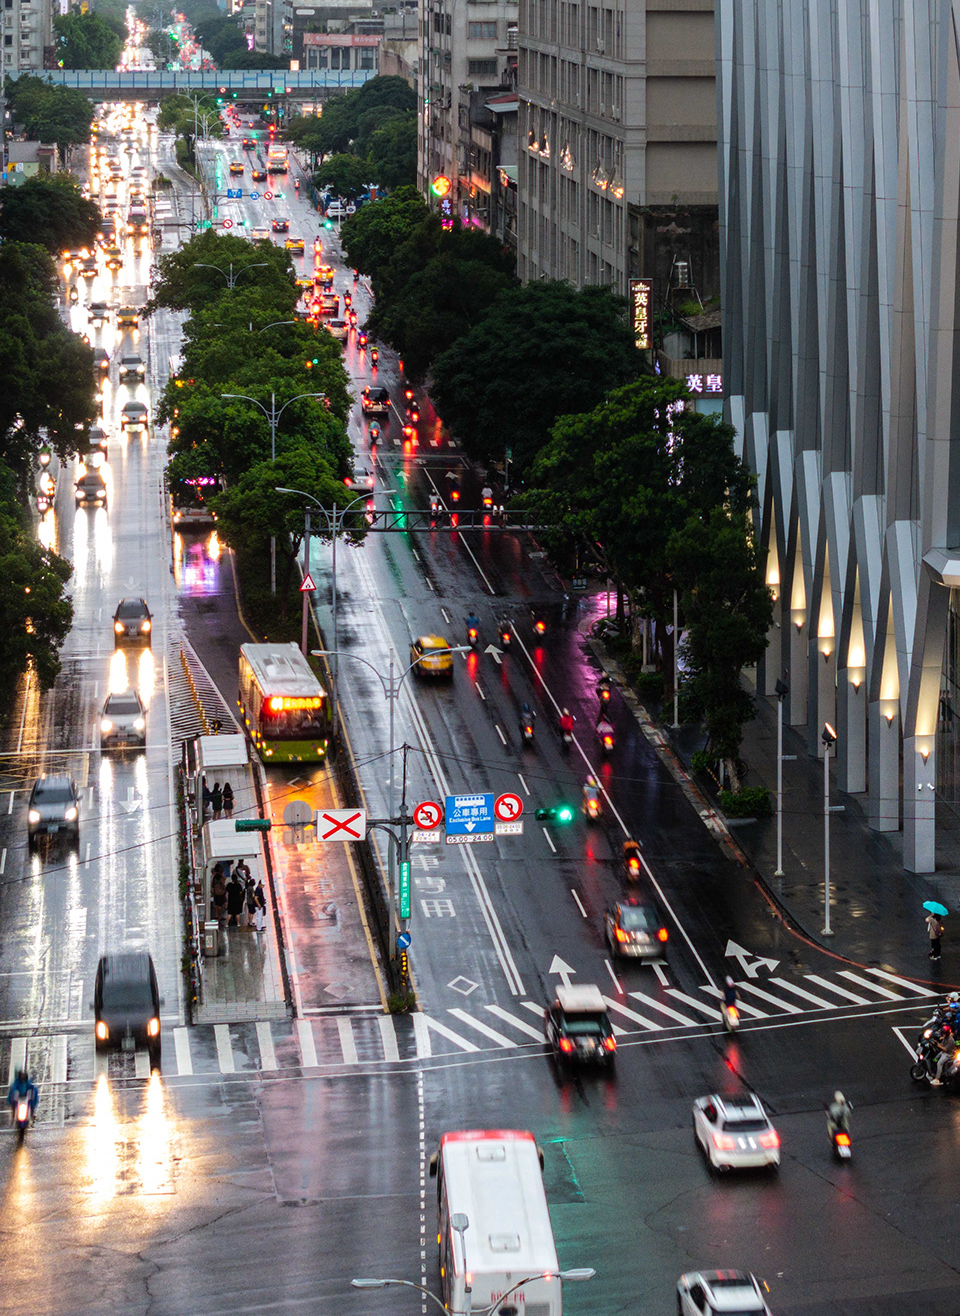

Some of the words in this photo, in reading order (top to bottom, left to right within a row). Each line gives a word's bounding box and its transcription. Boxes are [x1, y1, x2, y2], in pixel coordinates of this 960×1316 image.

[685, 373, 723, 393] 英皇
[453, 806, 488, 817] 公車專用
